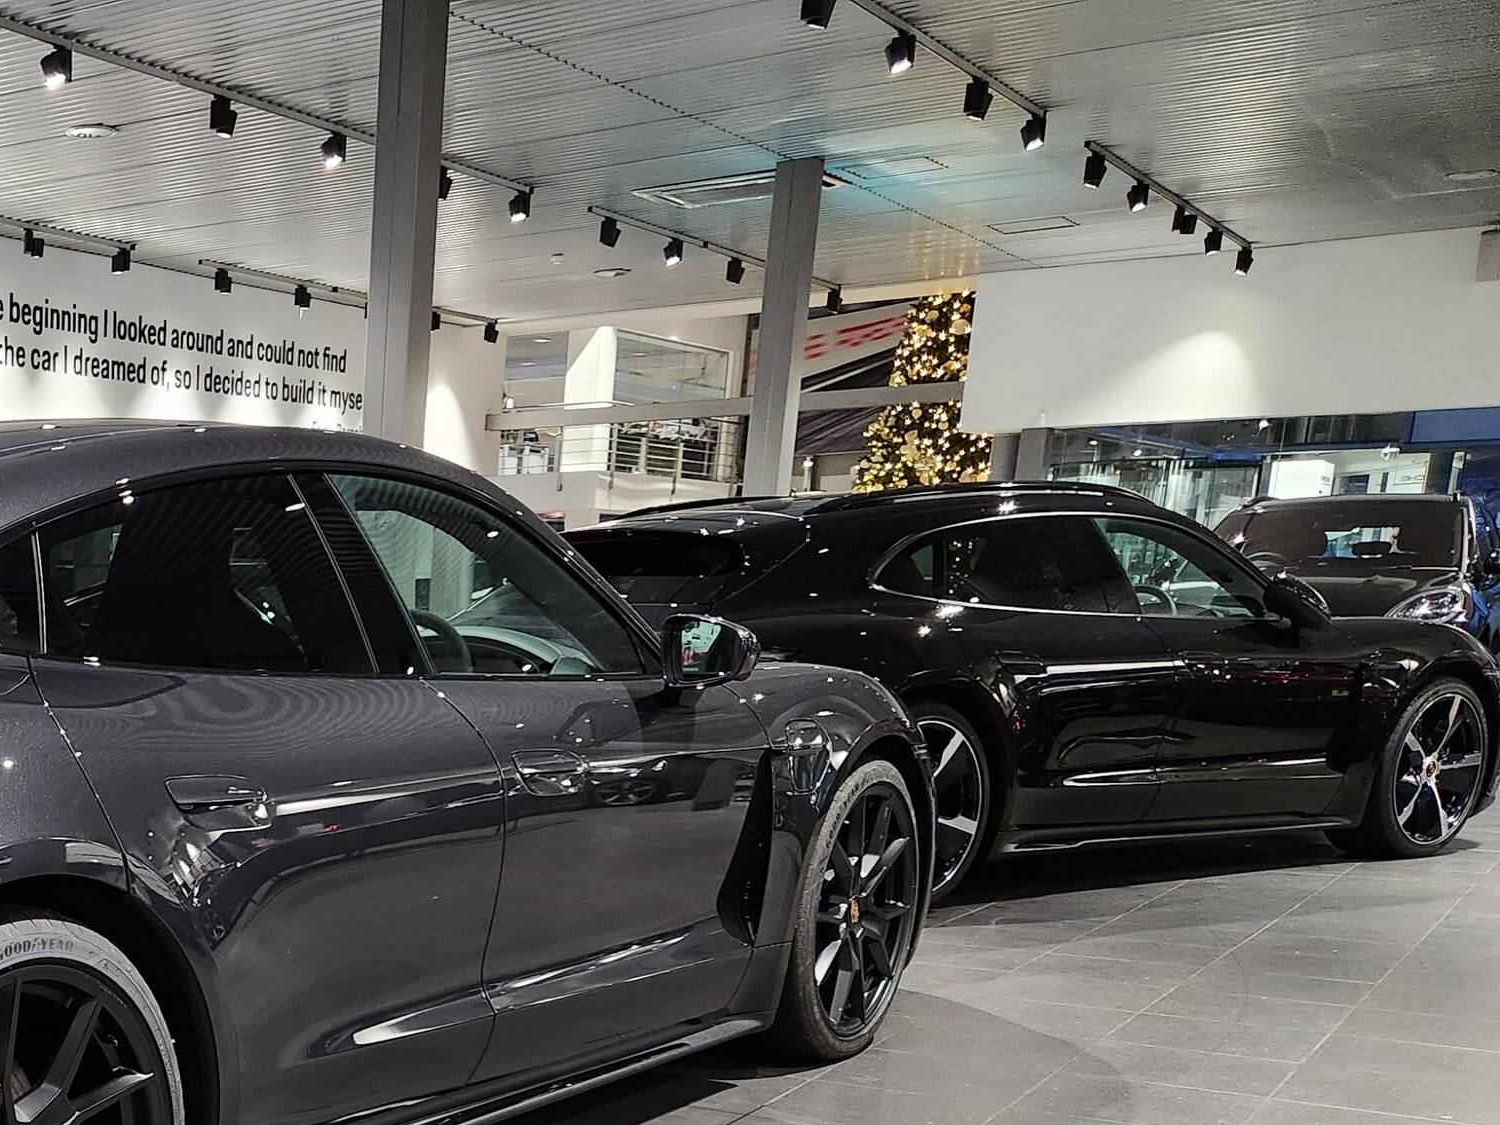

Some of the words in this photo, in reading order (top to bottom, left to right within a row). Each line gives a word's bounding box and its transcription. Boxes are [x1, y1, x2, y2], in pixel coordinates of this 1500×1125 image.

[9, 292, 99, 344] beginning
[103, 309, 108, 338] I
[112, 310, 166, 346] looked
[171, 329, 224, 355] around
[227, 334, 254, 360] and
[257, 339, 295, 366] could
[297, 348, 320, 369] not
[323, 347, 347, 373] find
[30, 348, 59, 373] car
[64, 345, 68, 374] I
[73, 347, 146, 384] dreamed
[174, 368, 192, 389] so
[196, 364, 201, 391] I
[204, 366, 261, 398] decided
[265, 376, 279, 400] to
[282, 376, 315, 405] build
[317, 381, 327, 406] it
